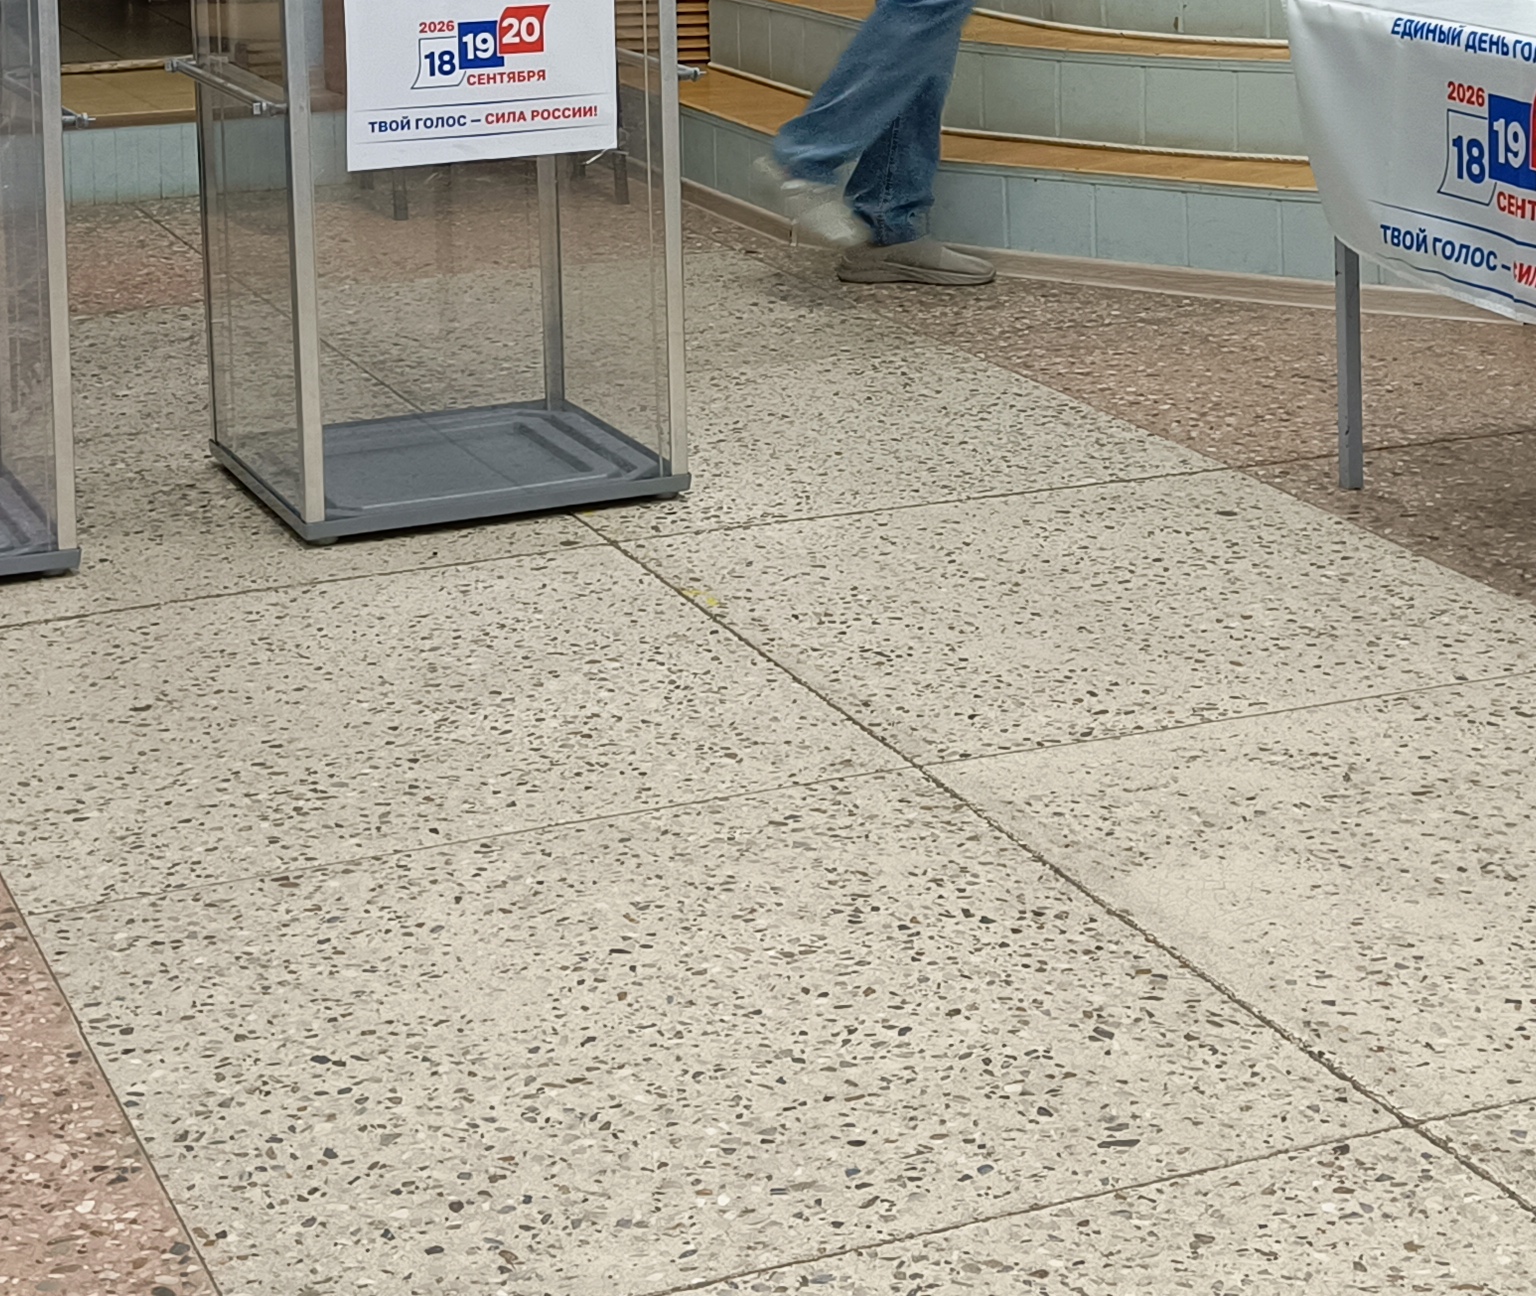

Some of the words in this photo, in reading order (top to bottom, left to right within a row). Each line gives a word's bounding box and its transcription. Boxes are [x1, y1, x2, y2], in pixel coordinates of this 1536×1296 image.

[418, 20, 455, 34] 2026
[1390, 17, 1466, 47] ЕДИНЫЙ
[1465, 30, 1510, 56] ДЕНЬ
[424, 50, 456, 77] 18
[462, 31, 495, 60] 19
[501, 15, 541, 44] 20
[466, 69, 546, 86] СЕНТЯБРЯ
[1447, 81, 1485, 108] 2026
[368, 116, 411, 133] ТВОЙ
[415, 115, 467, 130] ГОЛОС
[485, 109, 527, 125] СИЛА
[530, 105, 598, 121] РОССИИ!
[1451, 134, 1486, 184] 18
[1492, 117, 1527, 168] 19
[1380, 223, 1428, 254] ТВОЙ
[1432, 237, 1498, 271] ГОЛОС
